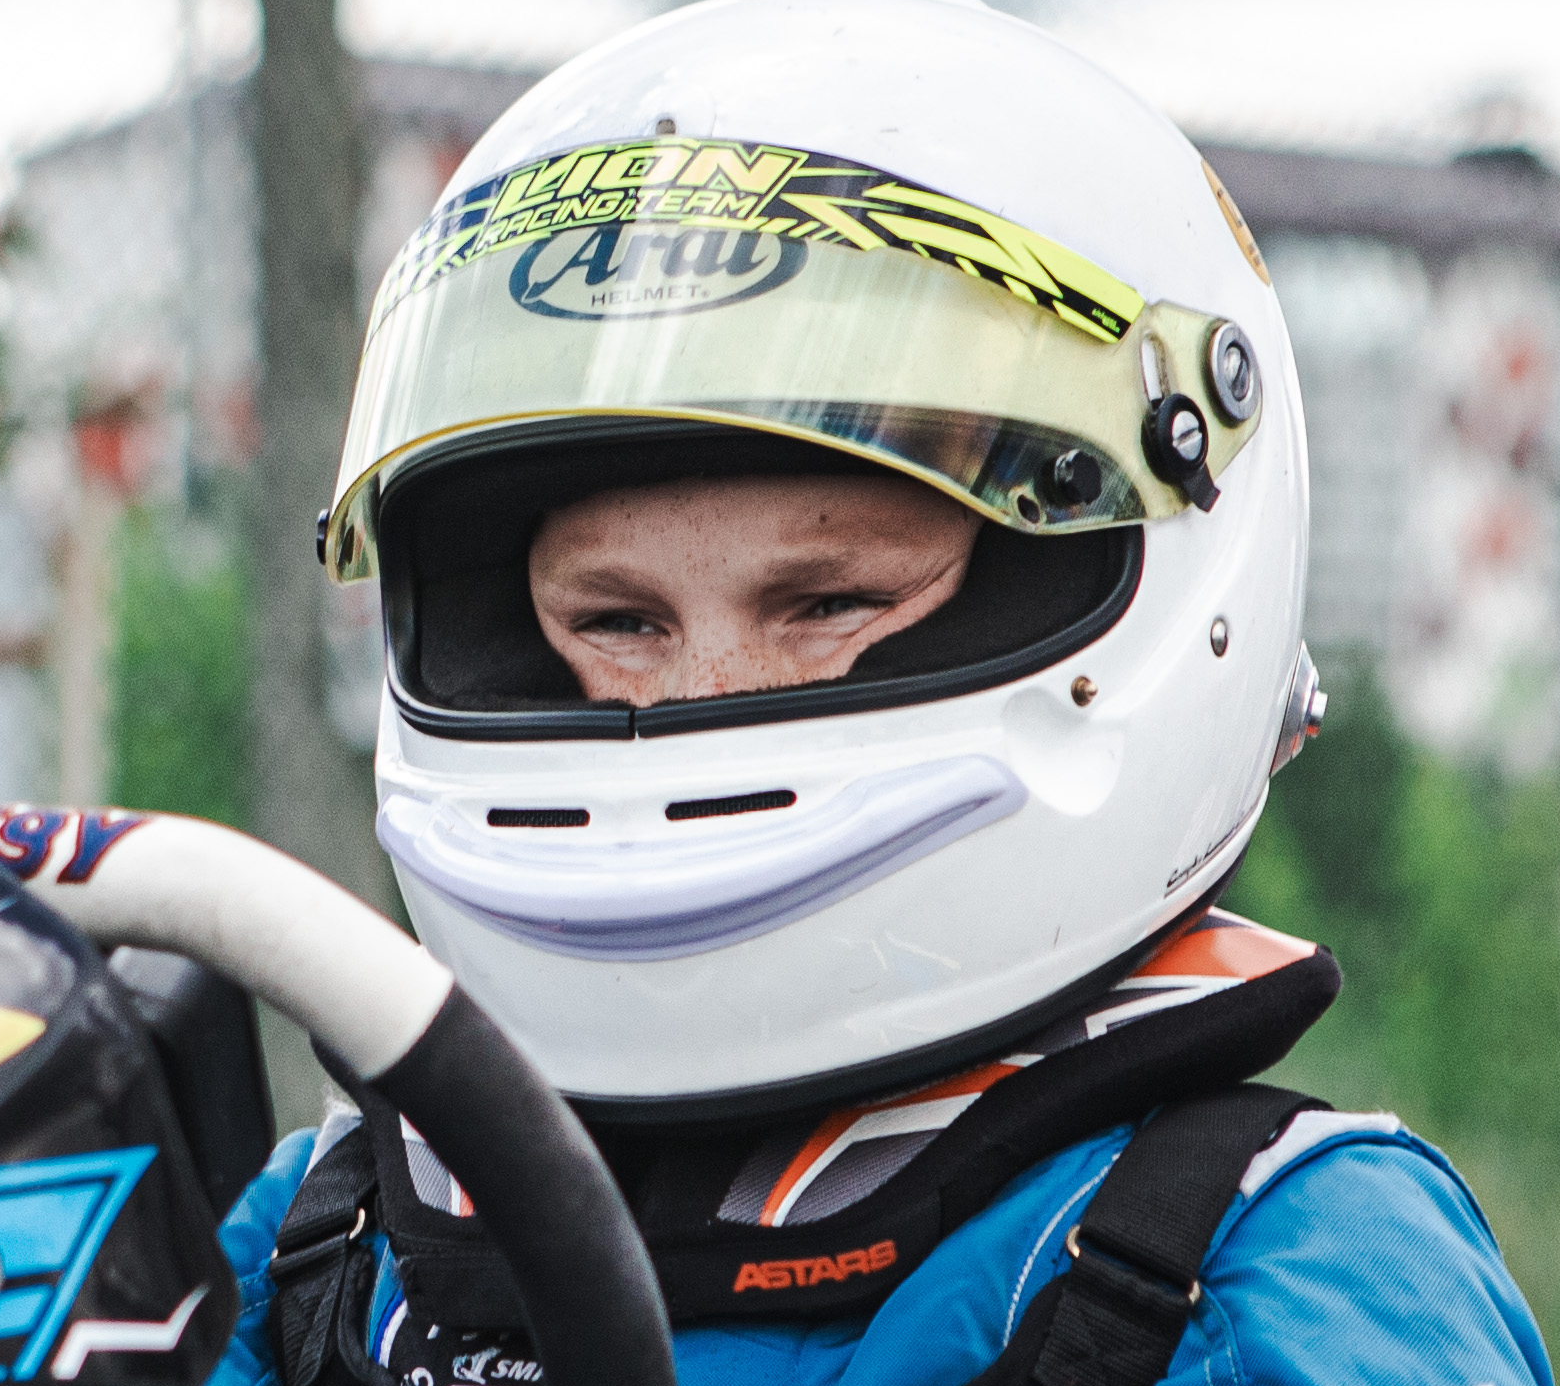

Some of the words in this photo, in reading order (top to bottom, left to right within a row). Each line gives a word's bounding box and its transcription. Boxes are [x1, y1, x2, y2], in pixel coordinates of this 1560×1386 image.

[492, 141, 795, 218] LION
[480, 189, 623, 246] RACING
[637, 189, 757, 218] TEAM
[732, 1239, 897, 1293] ASTARS
